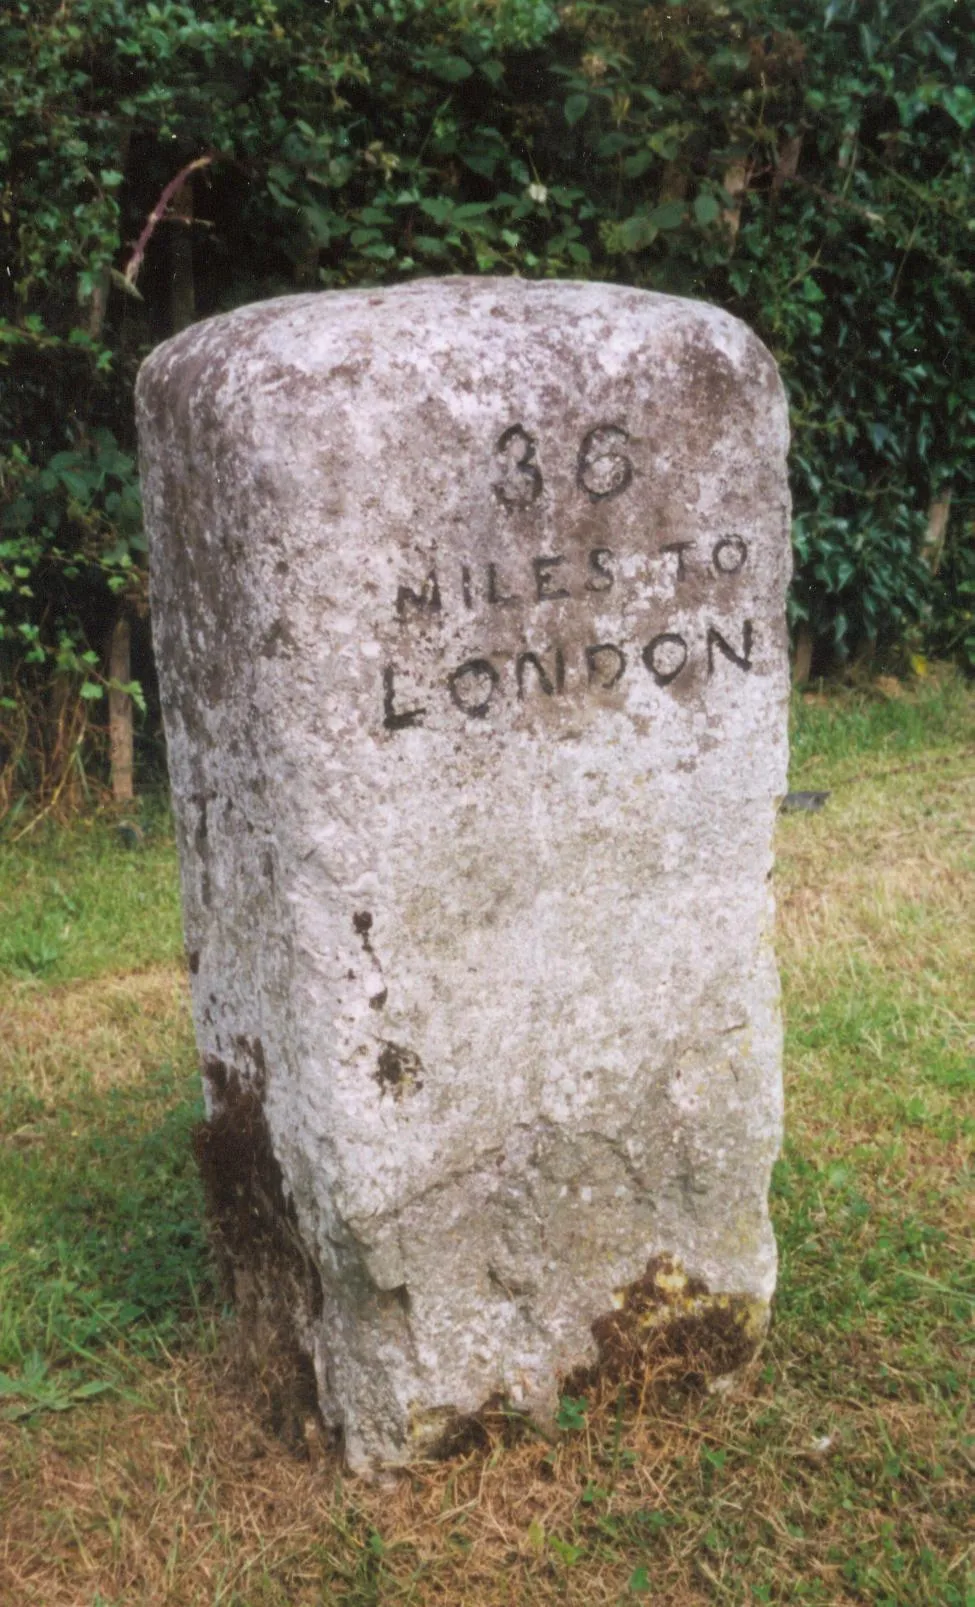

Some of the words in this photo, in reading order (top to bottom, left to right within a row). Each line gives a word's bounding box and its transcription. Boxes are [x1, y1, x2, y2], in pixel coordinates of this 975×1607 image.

[493, 423, 633, 507] 36
[395, 548, 615, 616] MILES
[659, 534, 748, 582] TO
[382, 619, 753, 730] LONDON
